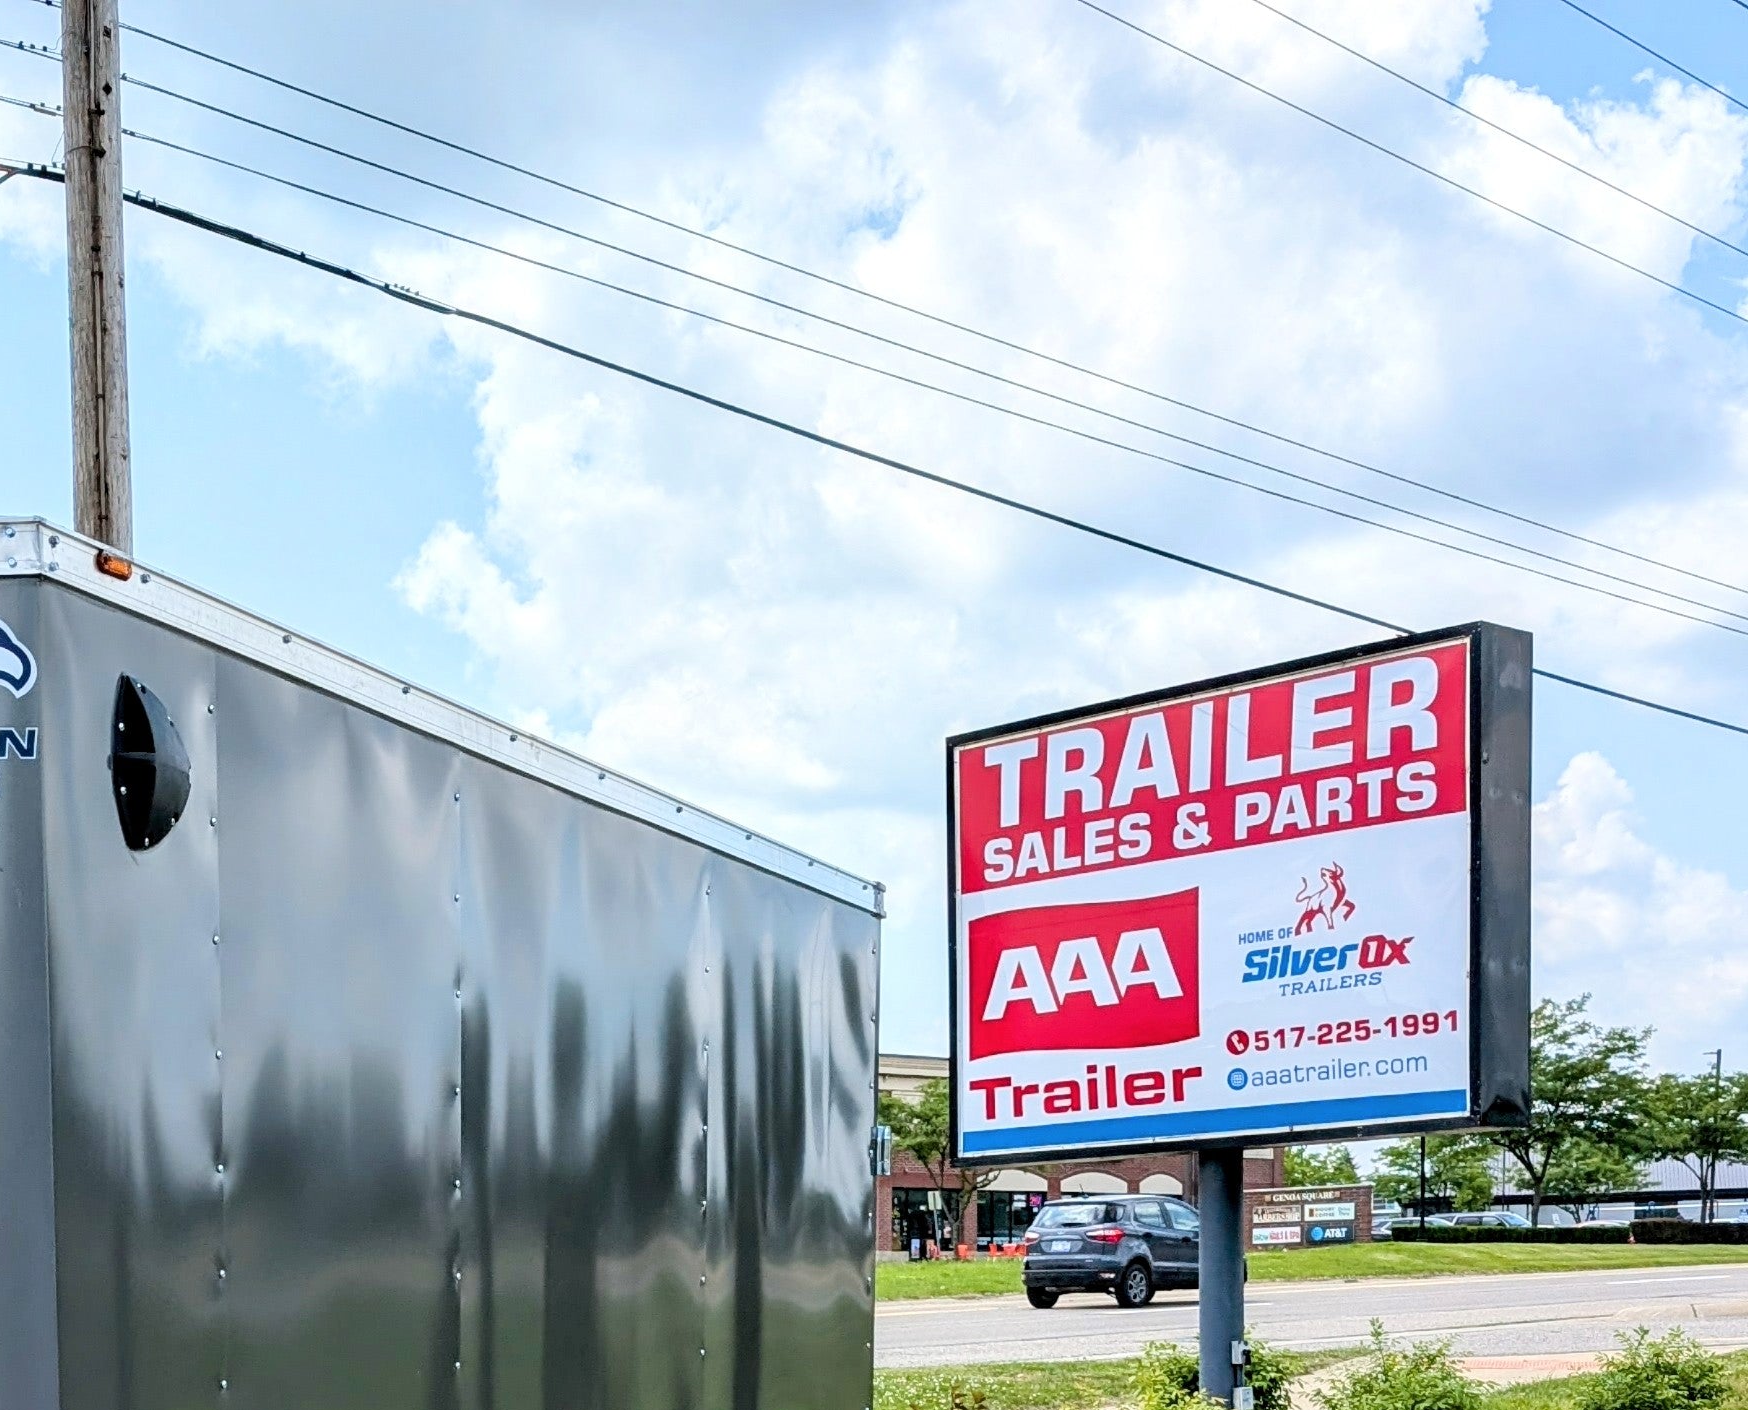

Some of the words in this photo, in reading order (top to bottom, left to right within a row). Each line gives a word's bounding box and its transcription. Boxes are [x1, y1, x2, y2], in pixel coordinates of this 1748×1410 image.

[984, 655, 1439, 829] TRAILER
[983, 812, 1151, 883] SALES
[1173, 802, 1212, 850] &
[1234, 761, 1438, 842] PARTS
[1238, 929, 1274, 945] HOME
[1278, 927, 1293, 940] OF
[982, 927, 1184, 1022] AAA
[1279, 972, 1382, 996] TRAILERS
[1254, 1010, 1458, 1051] 517-225-1991
[1252, 1055, 1428, 1086] aaatrailer.com
[969, 1066, 1202, 1121] Trailer
[1273, 1192, 1301, 1202] GENOA
[1302, 1191, 1334, 1202] SQUARE
[1324, 1227, 1348, 1238] AT&T
